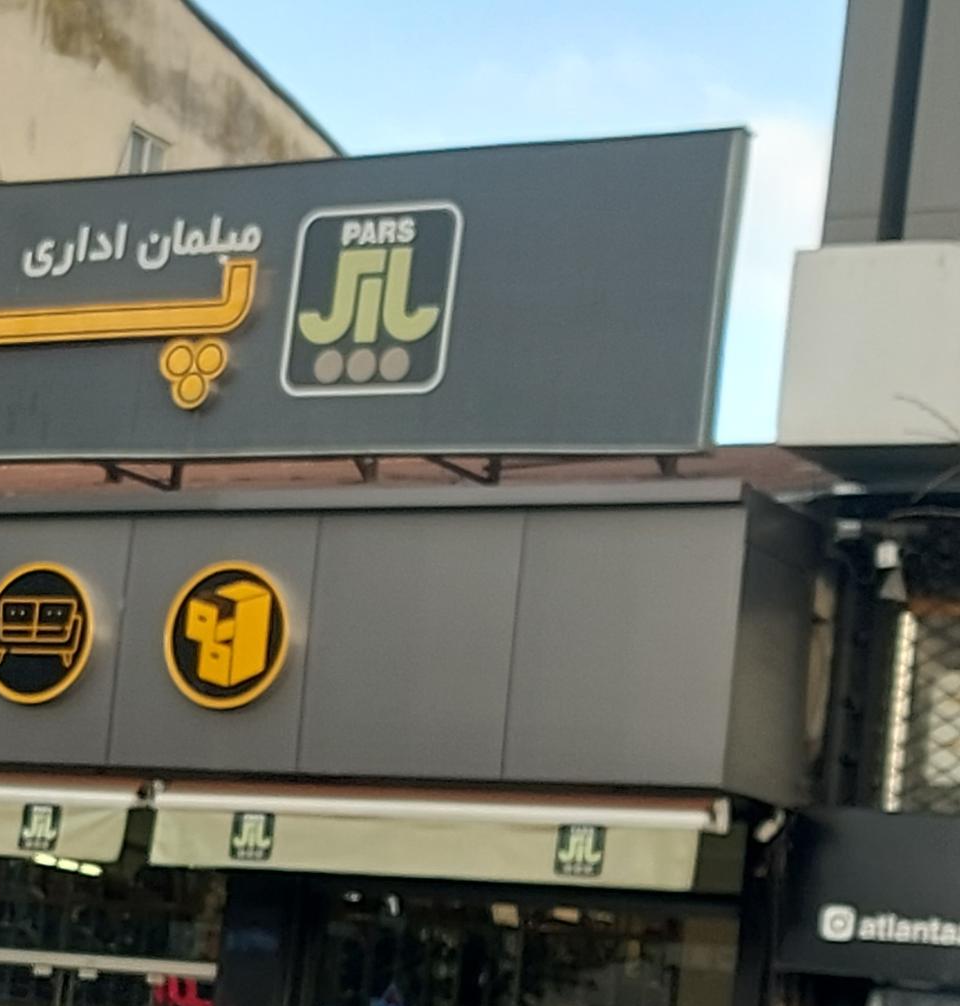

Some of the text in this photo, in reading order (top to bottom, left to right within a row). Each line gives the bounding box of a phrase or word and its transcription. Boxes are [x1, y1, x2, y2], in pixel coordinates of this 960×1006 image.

[22, 213, 262, 278] مبلمان اداری
[342, 216, 416, 247] PARS
[858, 913, 960, 946] atlanta
